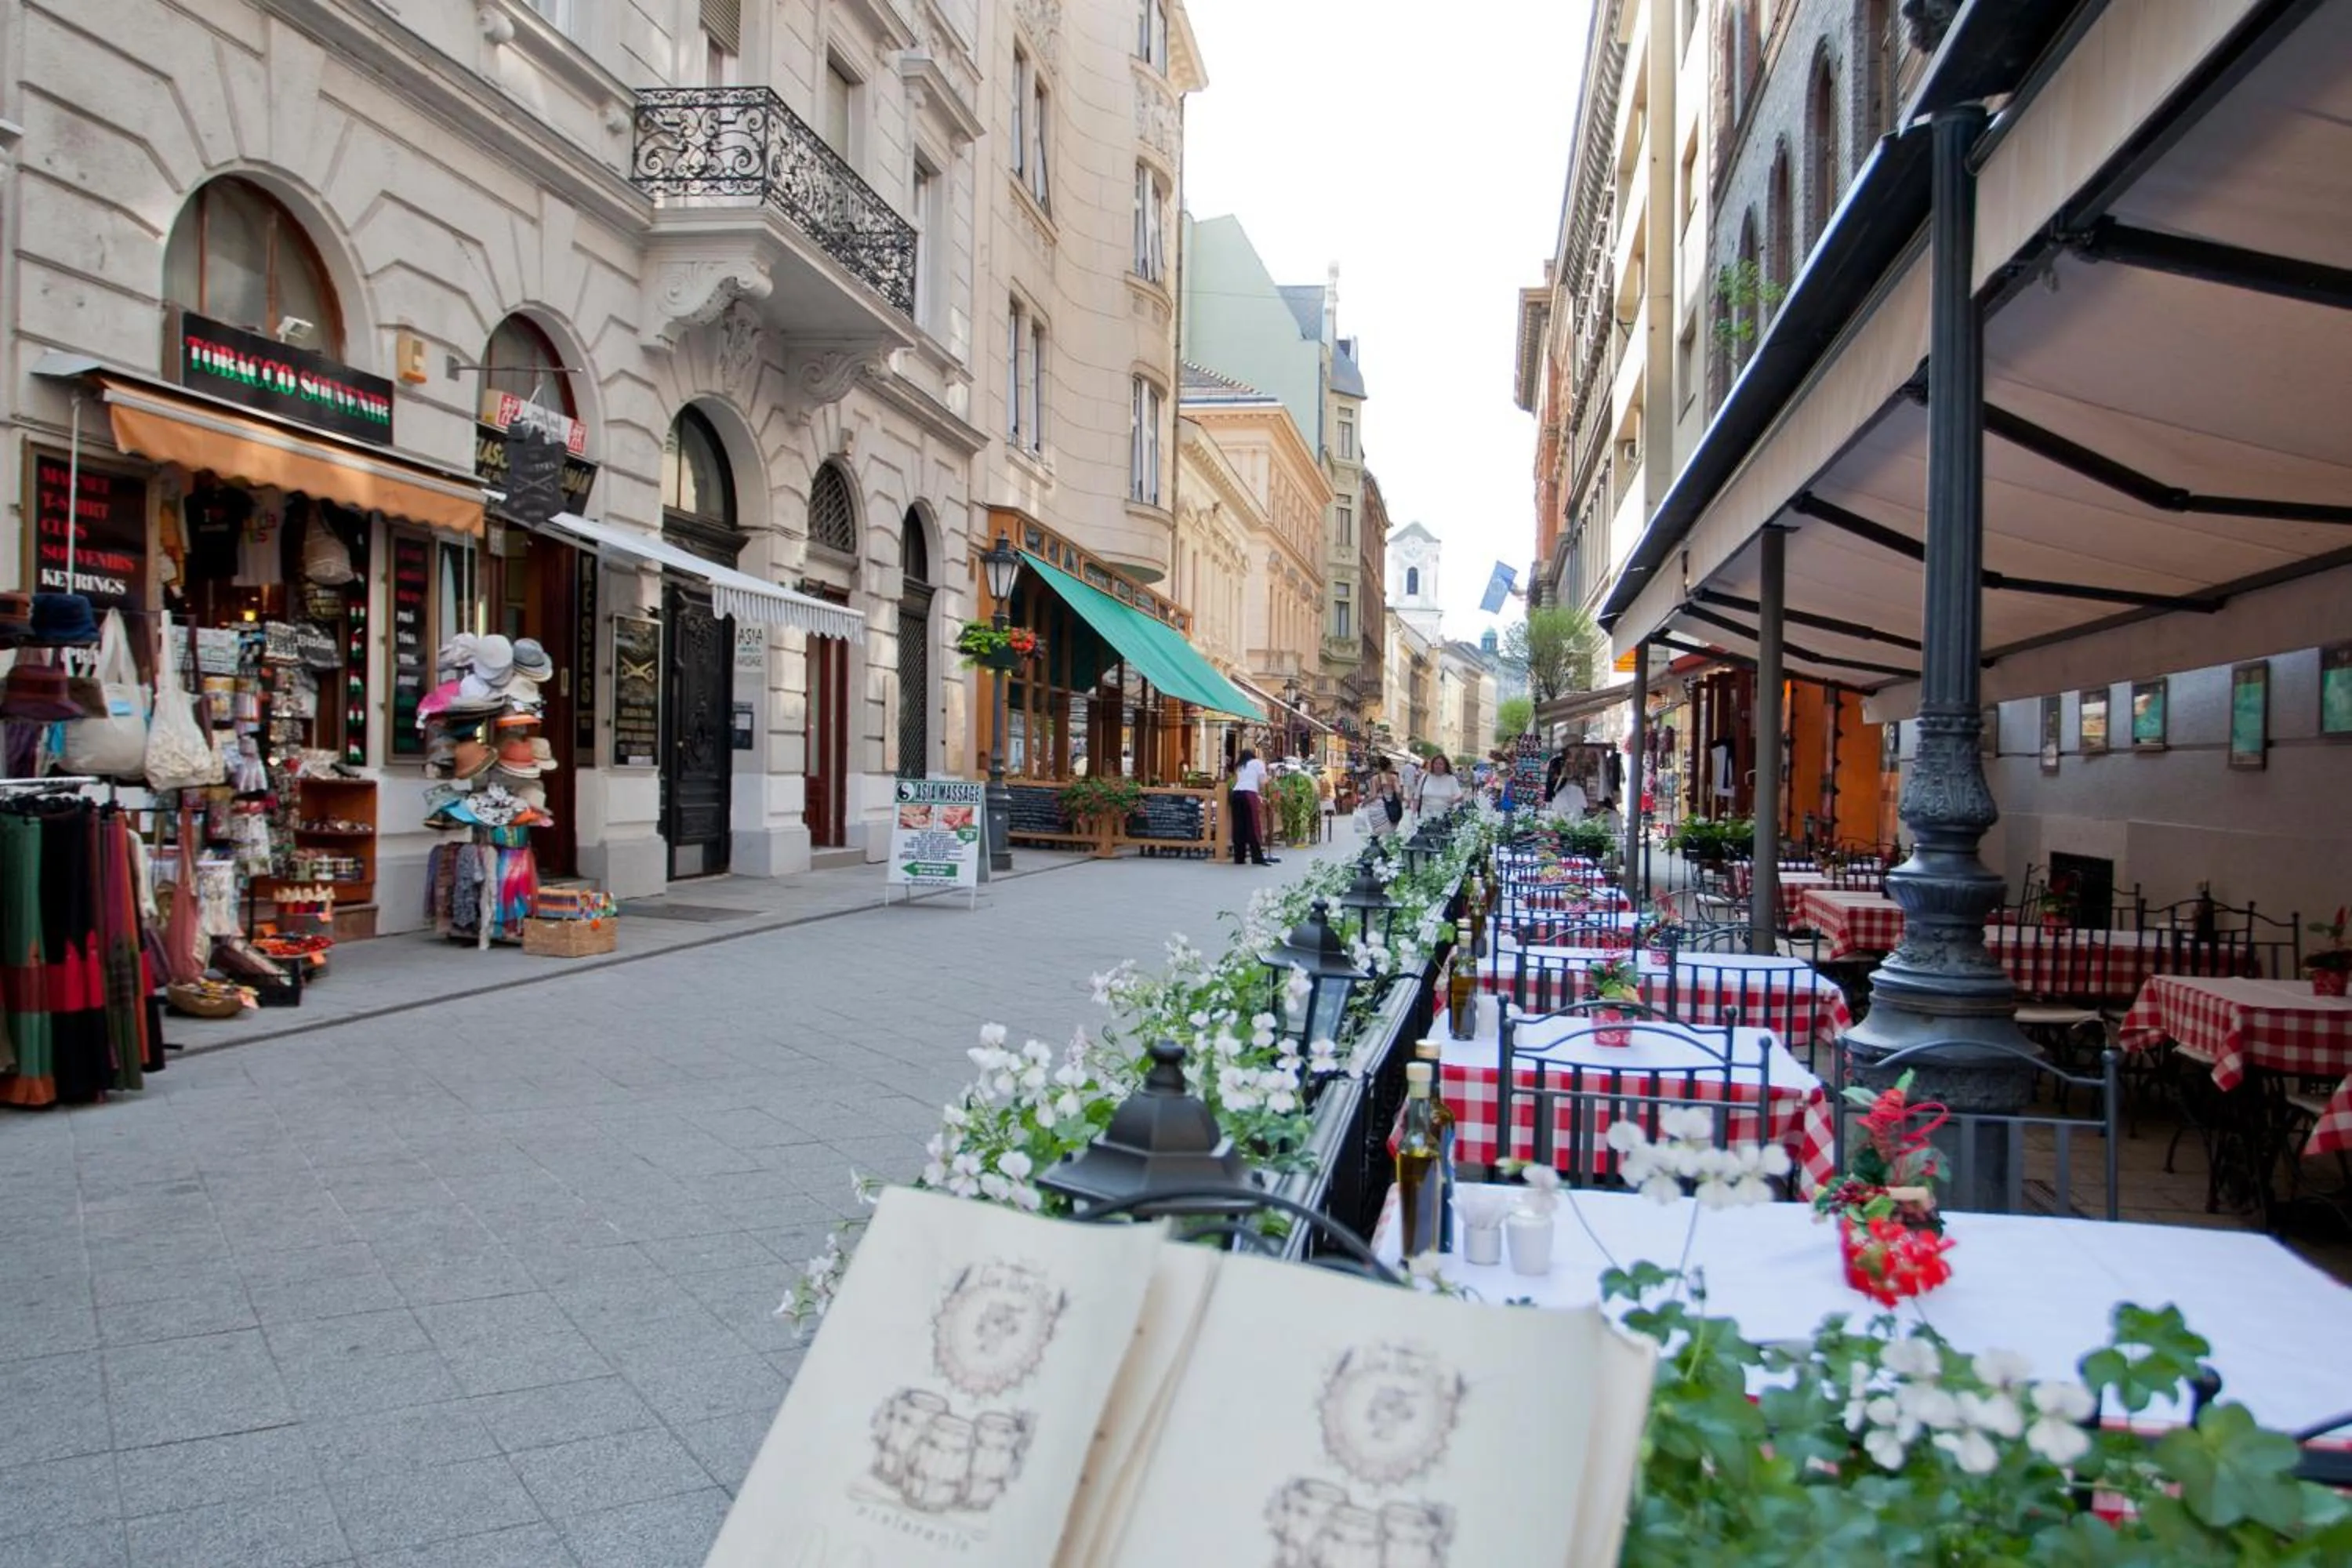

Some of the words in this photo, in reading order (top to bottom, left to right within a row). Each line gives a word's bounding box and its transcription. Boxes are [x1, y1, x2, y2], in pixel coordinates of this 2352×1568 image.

[186, 335, 297, 396] TOBACCO
[299, 368, 390, 426] SOUVENIR
[41, 465, 110, 495] MANET
[916, 782, 935, 801] ASIA
[939, 783, 980, 803] MASSAGE
